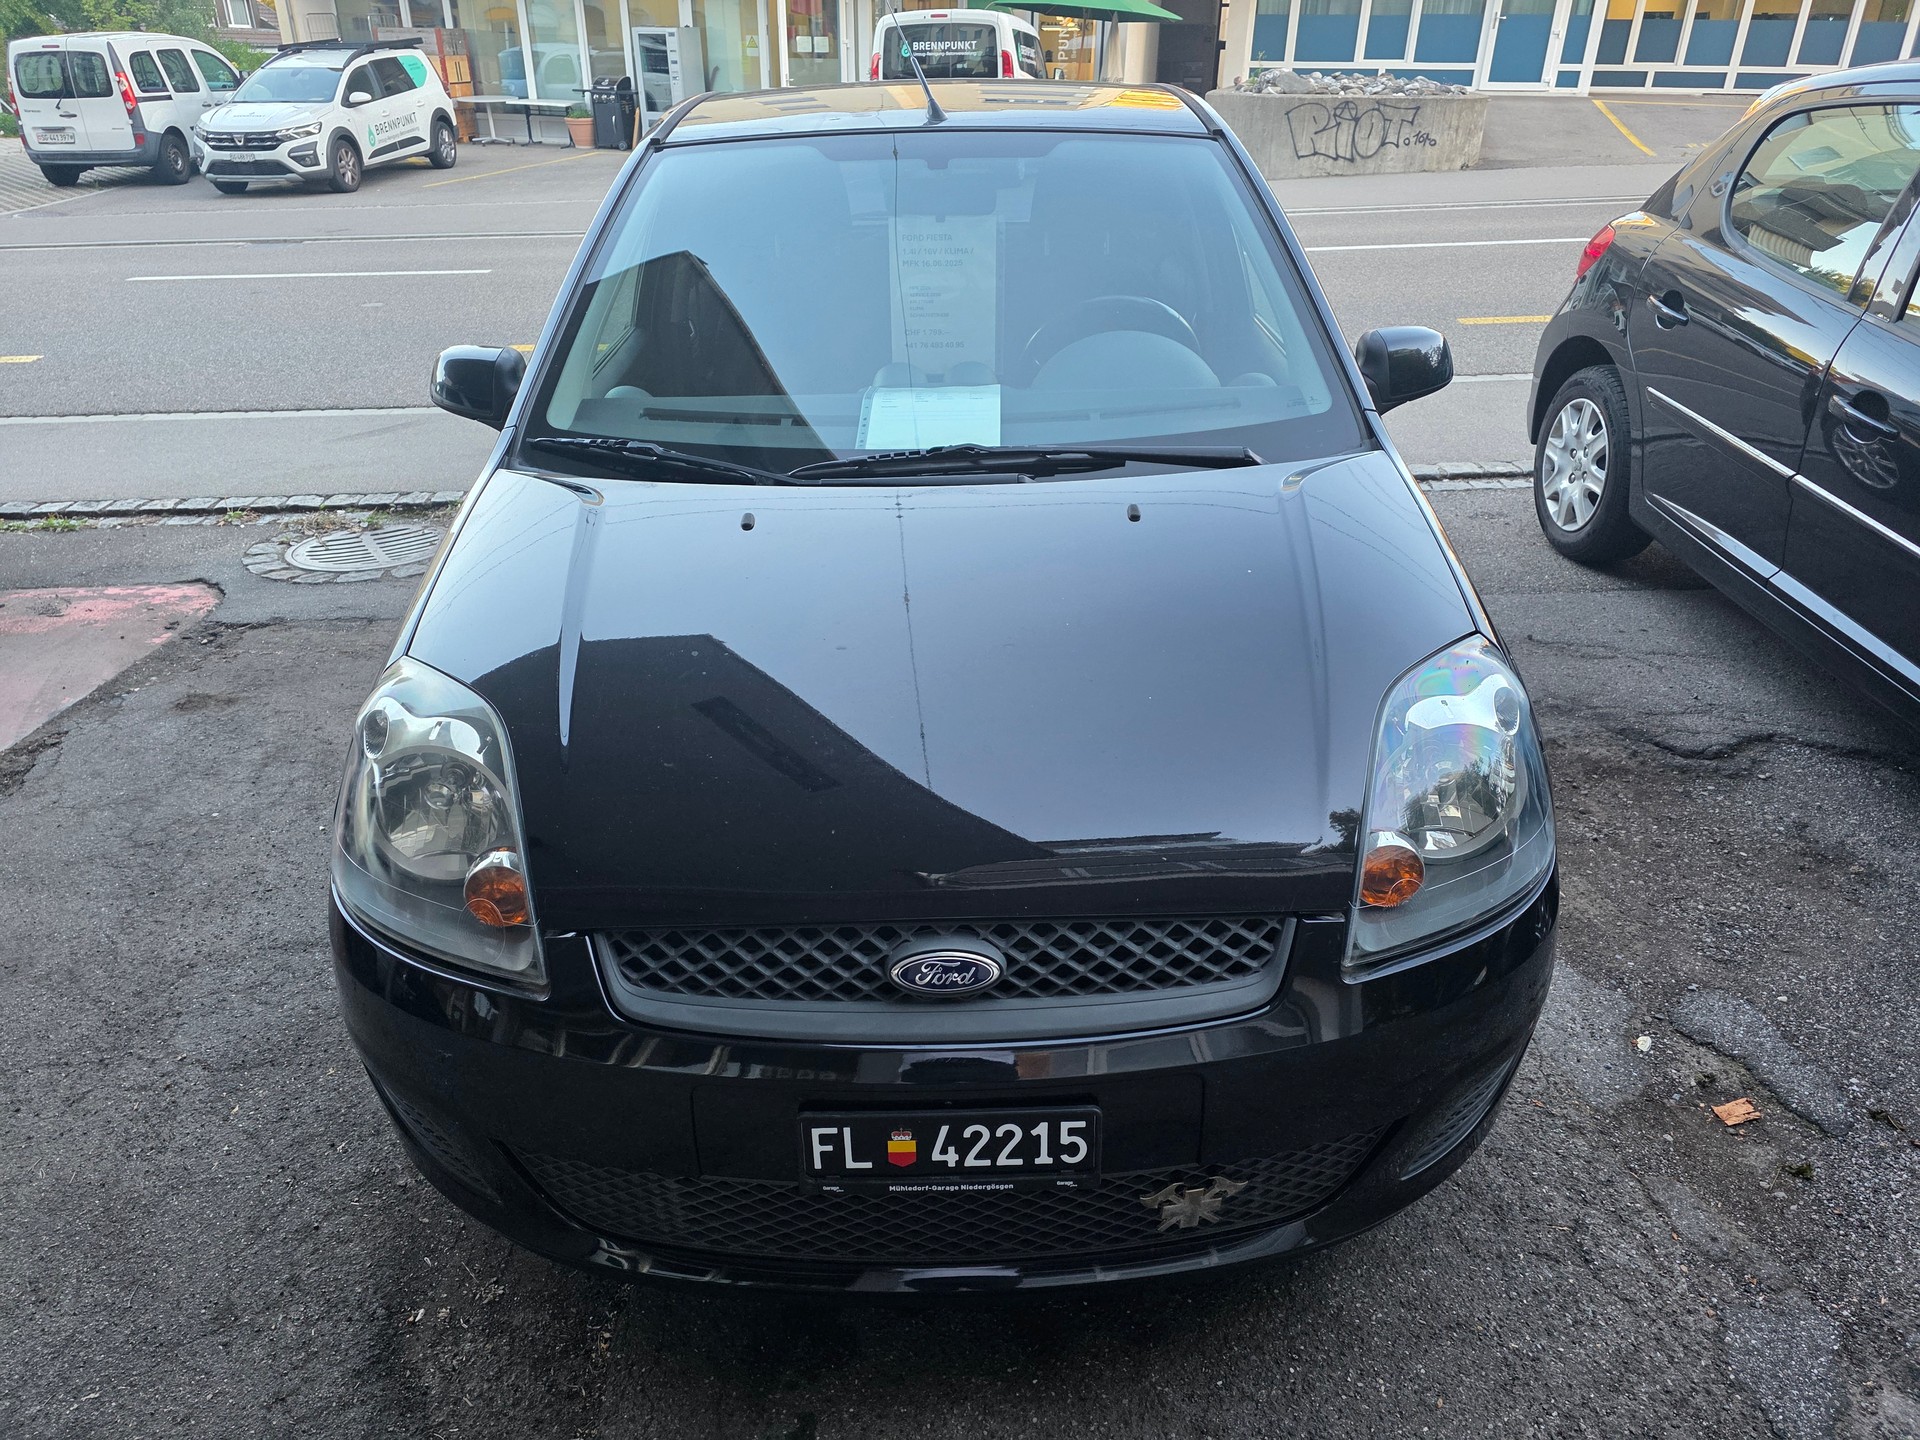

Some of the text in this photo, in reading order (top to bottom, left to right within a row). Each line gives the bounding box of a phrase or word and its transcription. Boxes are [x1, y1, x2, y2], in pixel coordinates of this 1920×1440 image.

[913, 40, 977, 51] BRENNPUNKT
[374, 111, 417, 136] BRENNPUNKT
[926, 233, 952, 241] FIESTA
[914, 961, 976, 985] Ford
[811, 1120, 1088, 1170] FL 42215
[889, 1182, 1014, 1192] Mühledorf-Garage Niedergösgen
